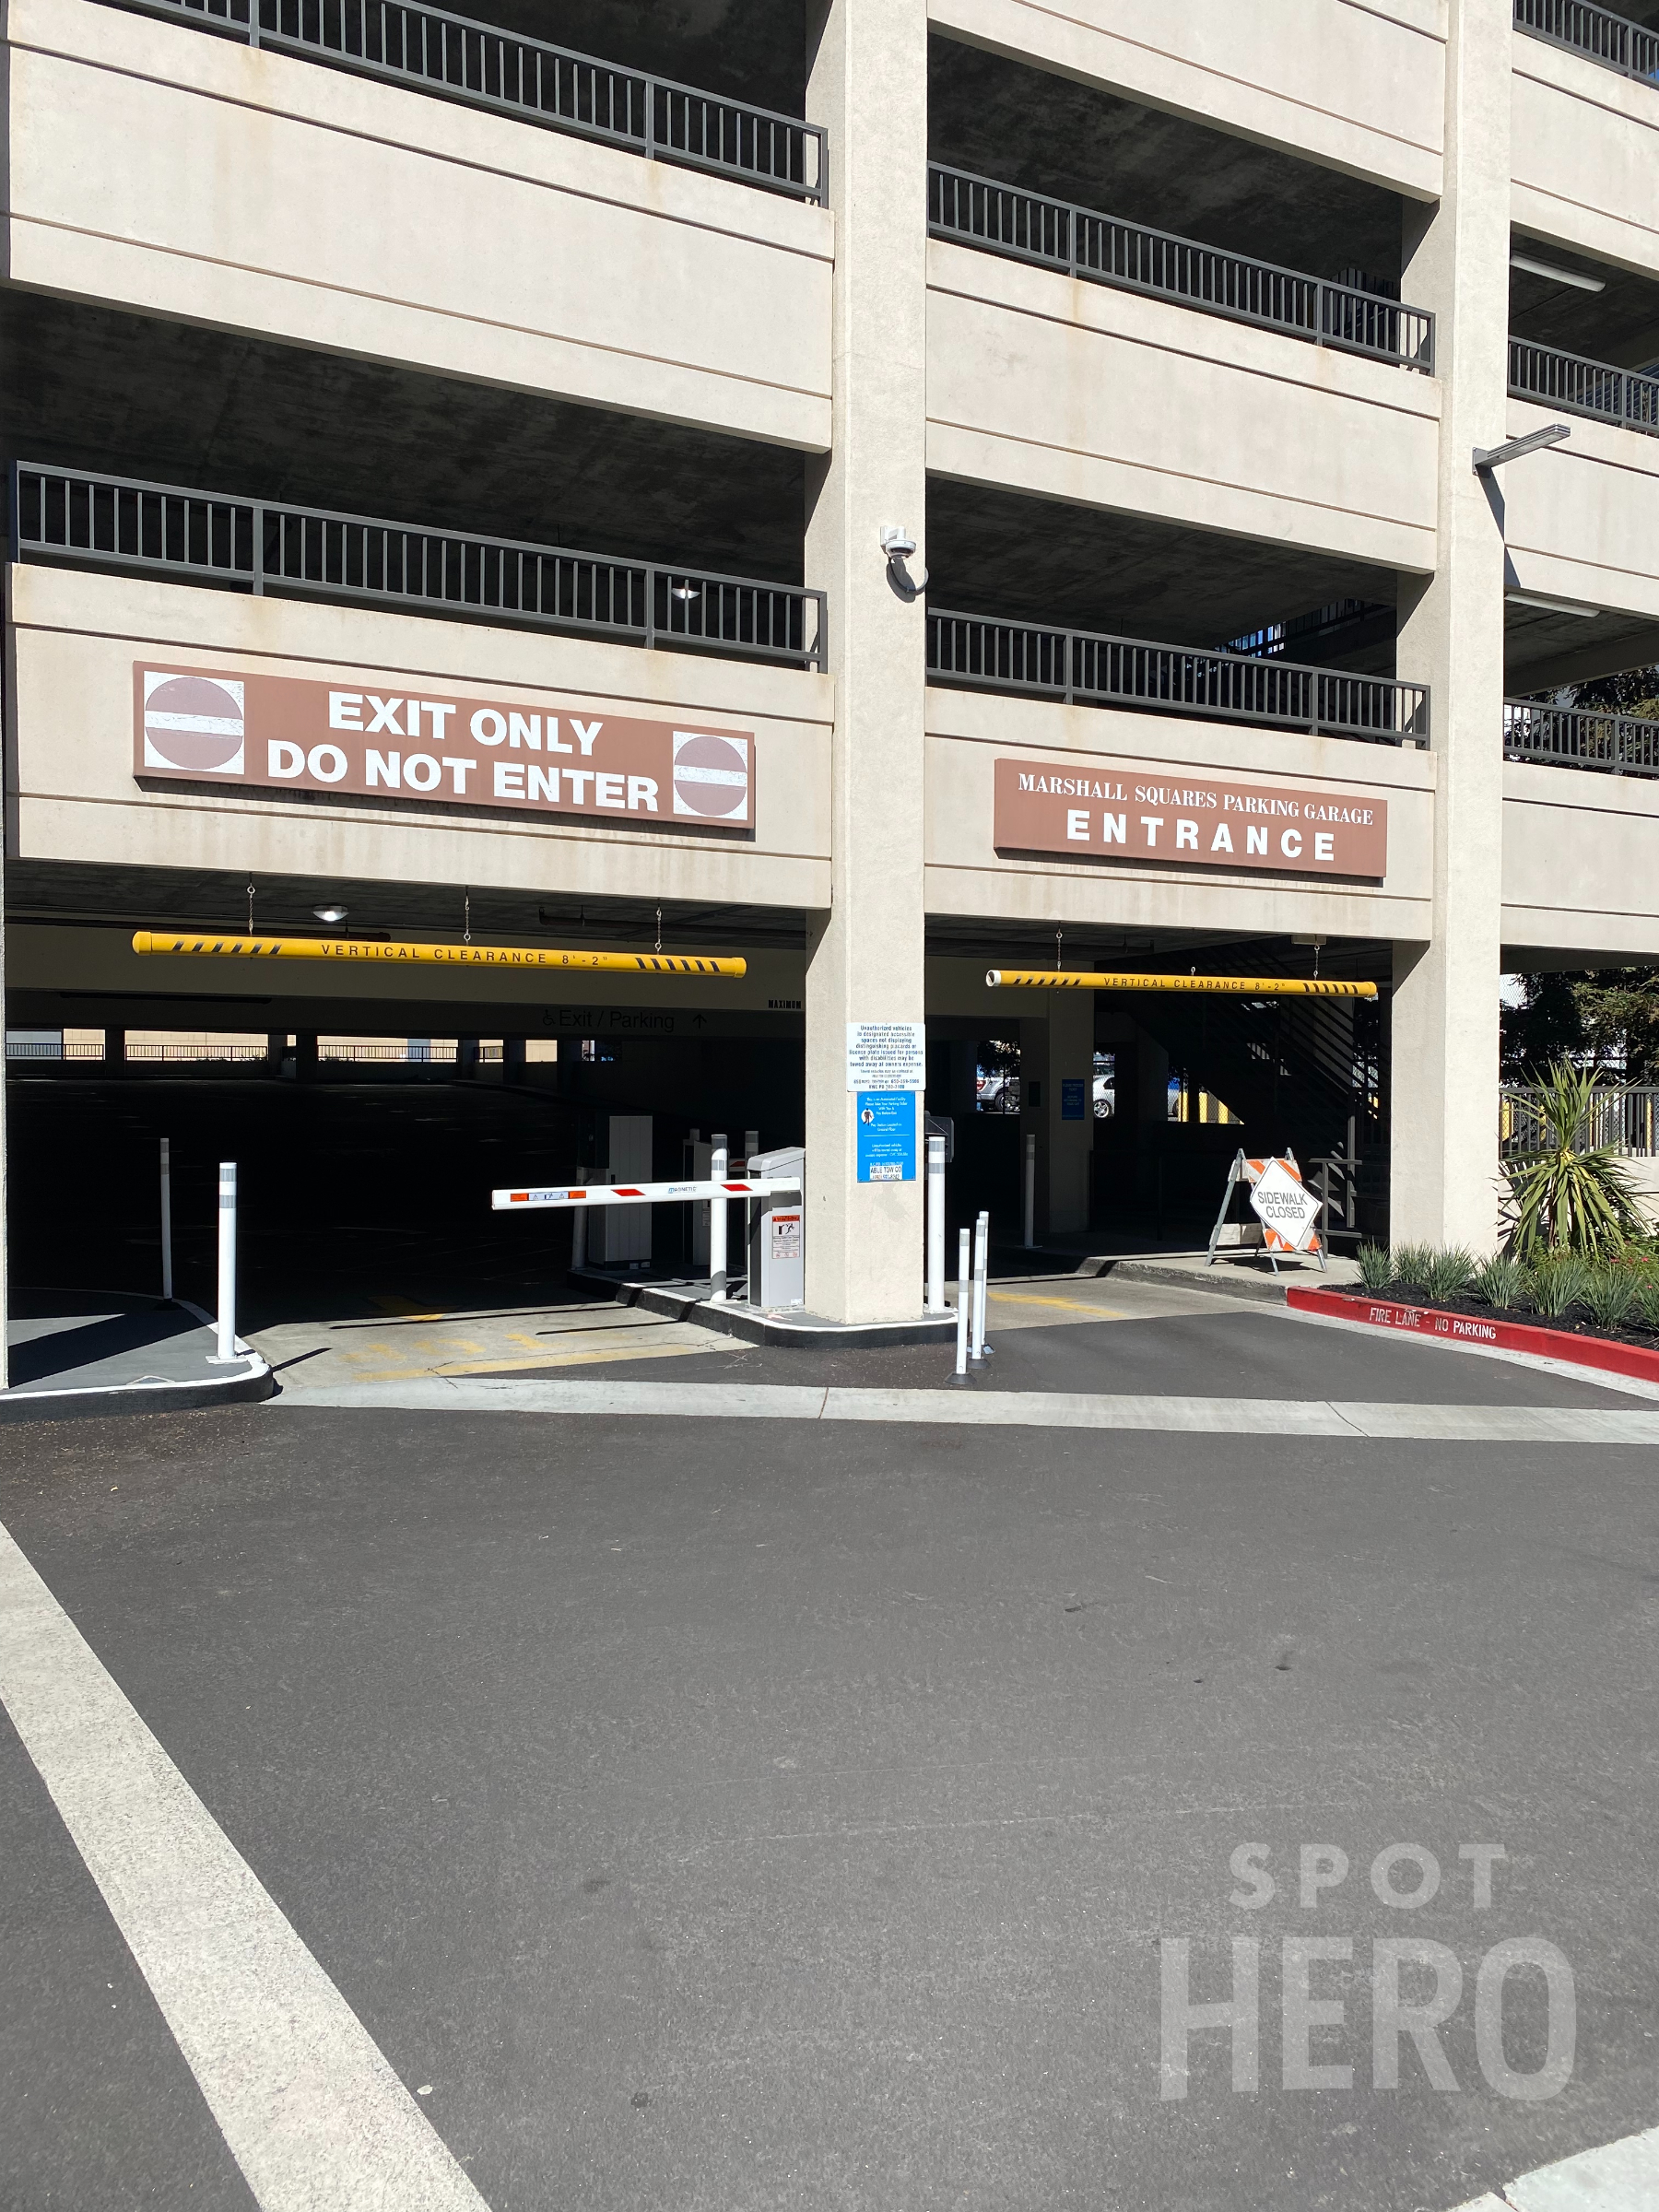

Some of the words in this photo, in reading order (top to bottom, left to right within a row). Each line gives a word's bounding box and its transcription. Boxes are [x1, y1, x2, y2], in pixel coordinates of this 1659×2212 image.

[327, 690, 456, 740] EXIT
[470, 707, 604, 758] ONLY
[266, 738, 349, 785] DO
[367, 749, 477, 795] NOT
[493, 760, 660, 813] ENTER
[1018, 771, 1128, 802] MARSHALL
[1134, 783, 1218, 809] SQUARES
[1222, 793, 1300, 819] PARKING
[1303, 801, 1374, 826] GARAGE
[1065, 808, 1335, 863] ENTRANCE
[321, 944, 420, 959] VERTICAL
[433, 948, 547, 964] CLEARANCE
[1103, 977, 1166, 988] VERTICAL
[1173, 979, 1245, 990] CLEARANCE
[768, 999, 802, 1009] MAXIMUM
[559, 1009, 593, 1027] Exit
[609, 1010, 675, 1033] Parking
[1257, 1191, 1308, 1206] SIDEWALK
[1265, 1206, 1306, 1219] CLOSED
[1369, 1306, 1393, 1324] FIRE
[1394, 1310, 1422, 1328] LANE
[1434, 1317, 1449, 1332] NO
[1453, 1320, 1497, 1339] PARKING
